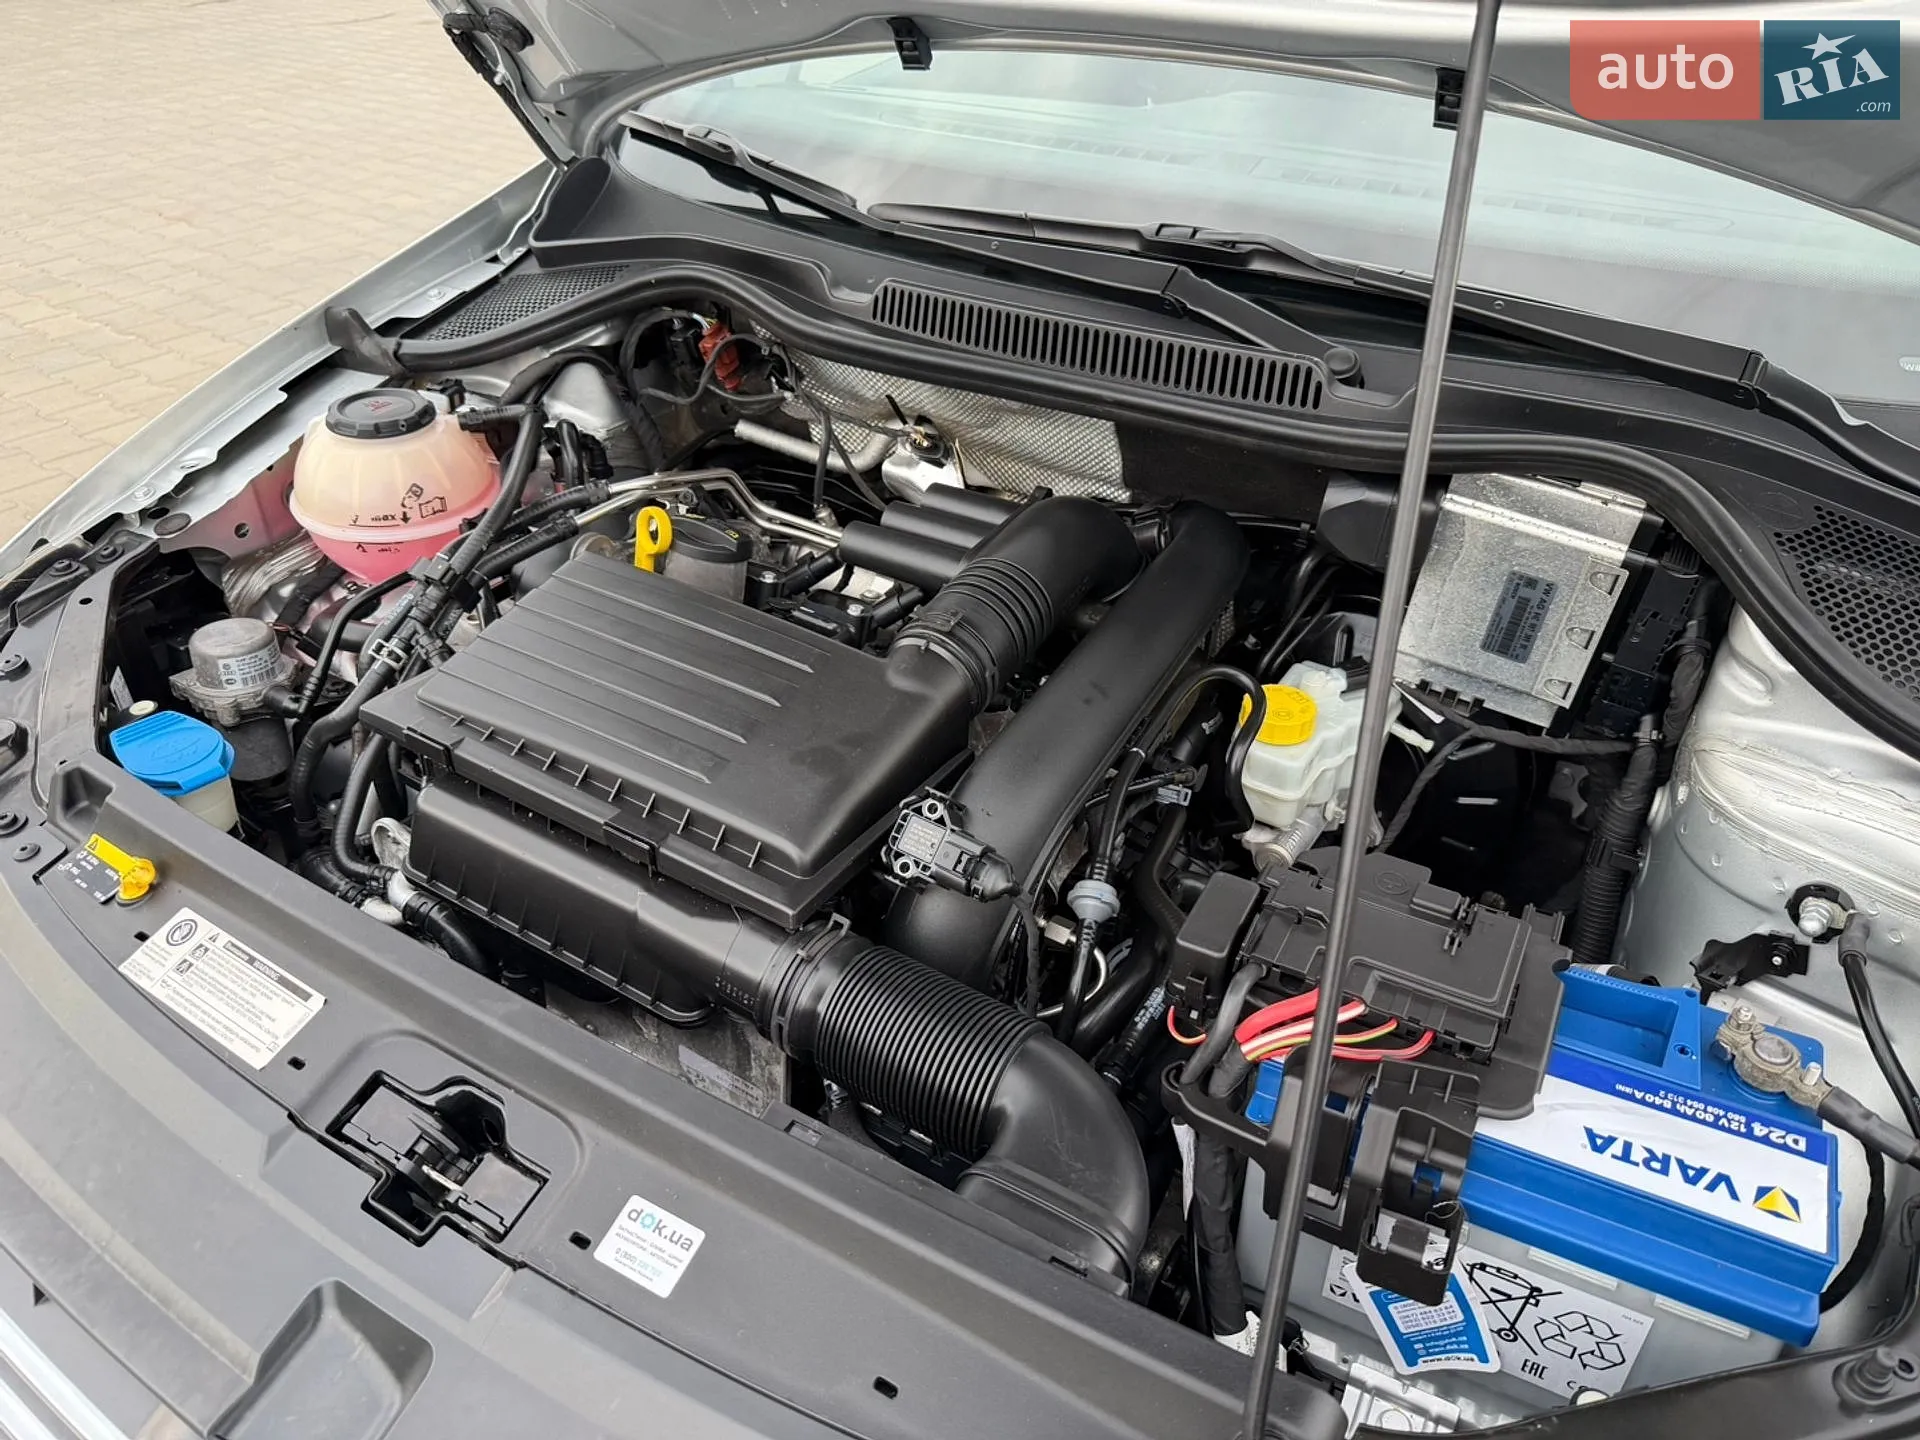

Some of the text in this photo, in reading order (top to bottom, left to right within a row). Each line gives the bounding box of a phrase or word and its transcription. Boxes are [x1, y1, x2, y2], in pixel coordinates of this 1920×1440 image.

[1718, 1116, 1747, 1132] 12V
[1749, 1121, 1809, 1152] D24
[1582, 1126, 1740, 1202] VARTA
[627, 1208, 693, 1252] dok.ua
